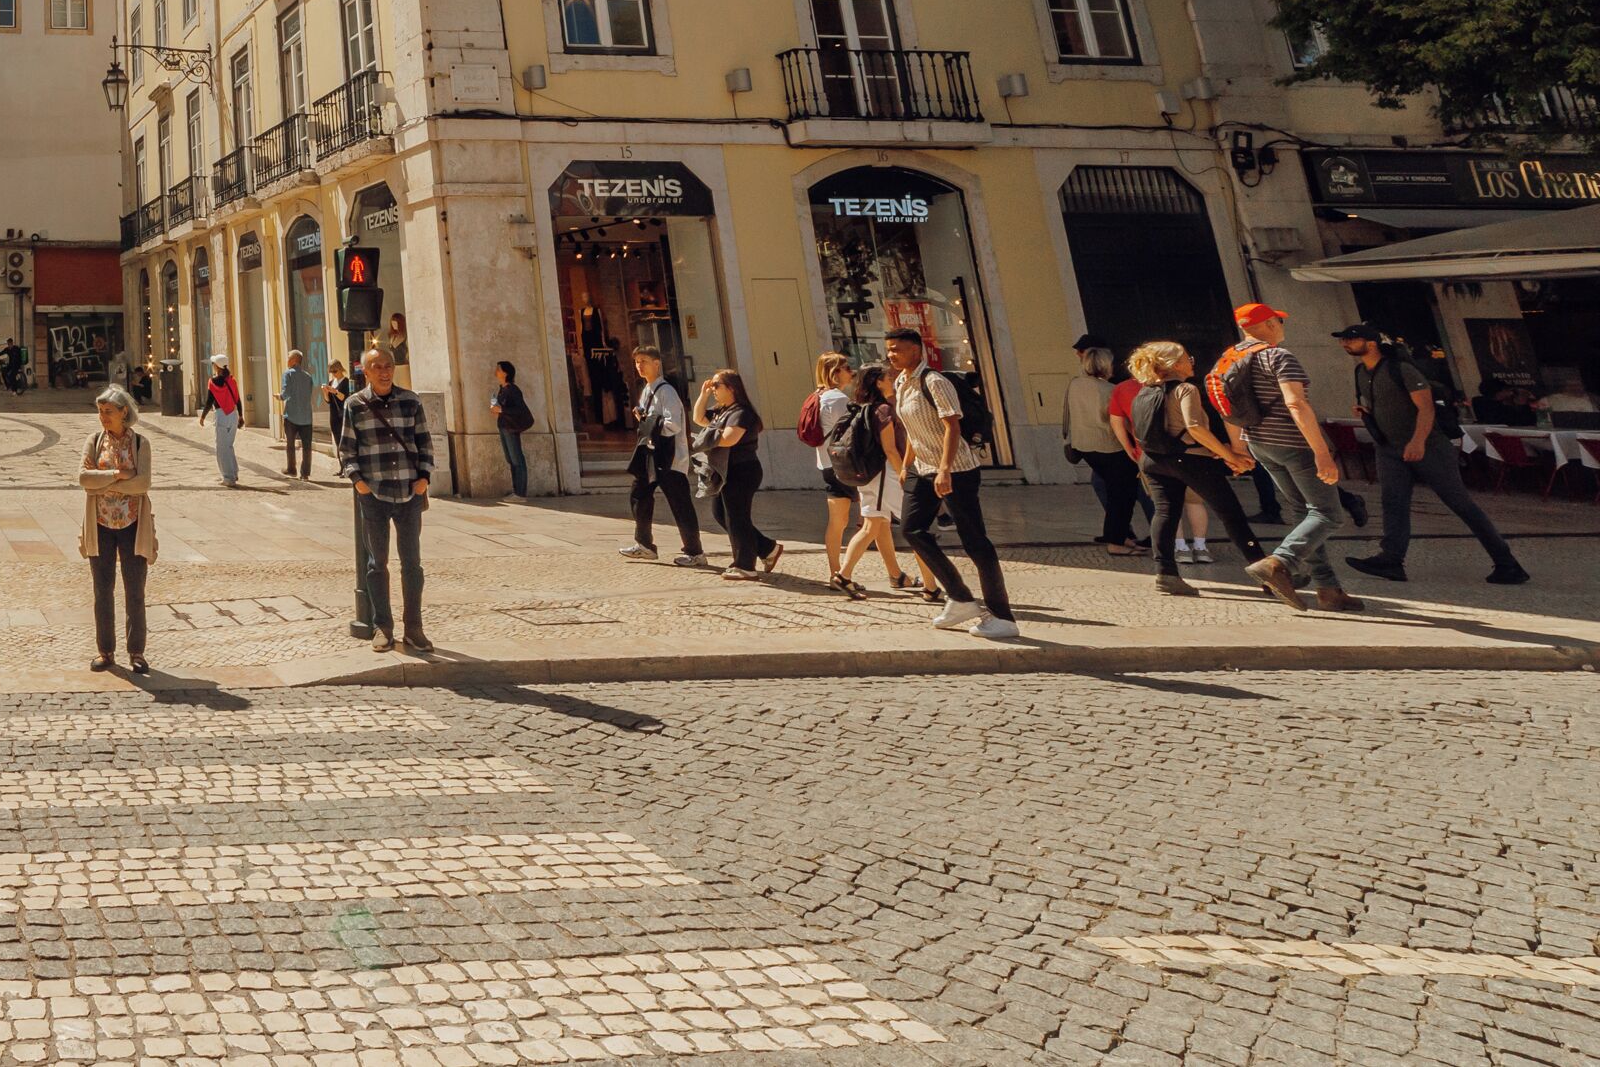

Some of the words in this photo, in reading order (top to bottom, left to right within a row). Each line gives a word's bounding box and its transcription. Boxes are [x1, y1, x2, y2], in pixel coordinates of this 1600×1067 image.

[620, 146, 633, 159] 15
[877, 150, 889, 162] 16
[1120, 151, 1130, 163] 17
[577, 175, 683, 197] TEZENIS
[828, 194, 929, 216] TEZENIS
